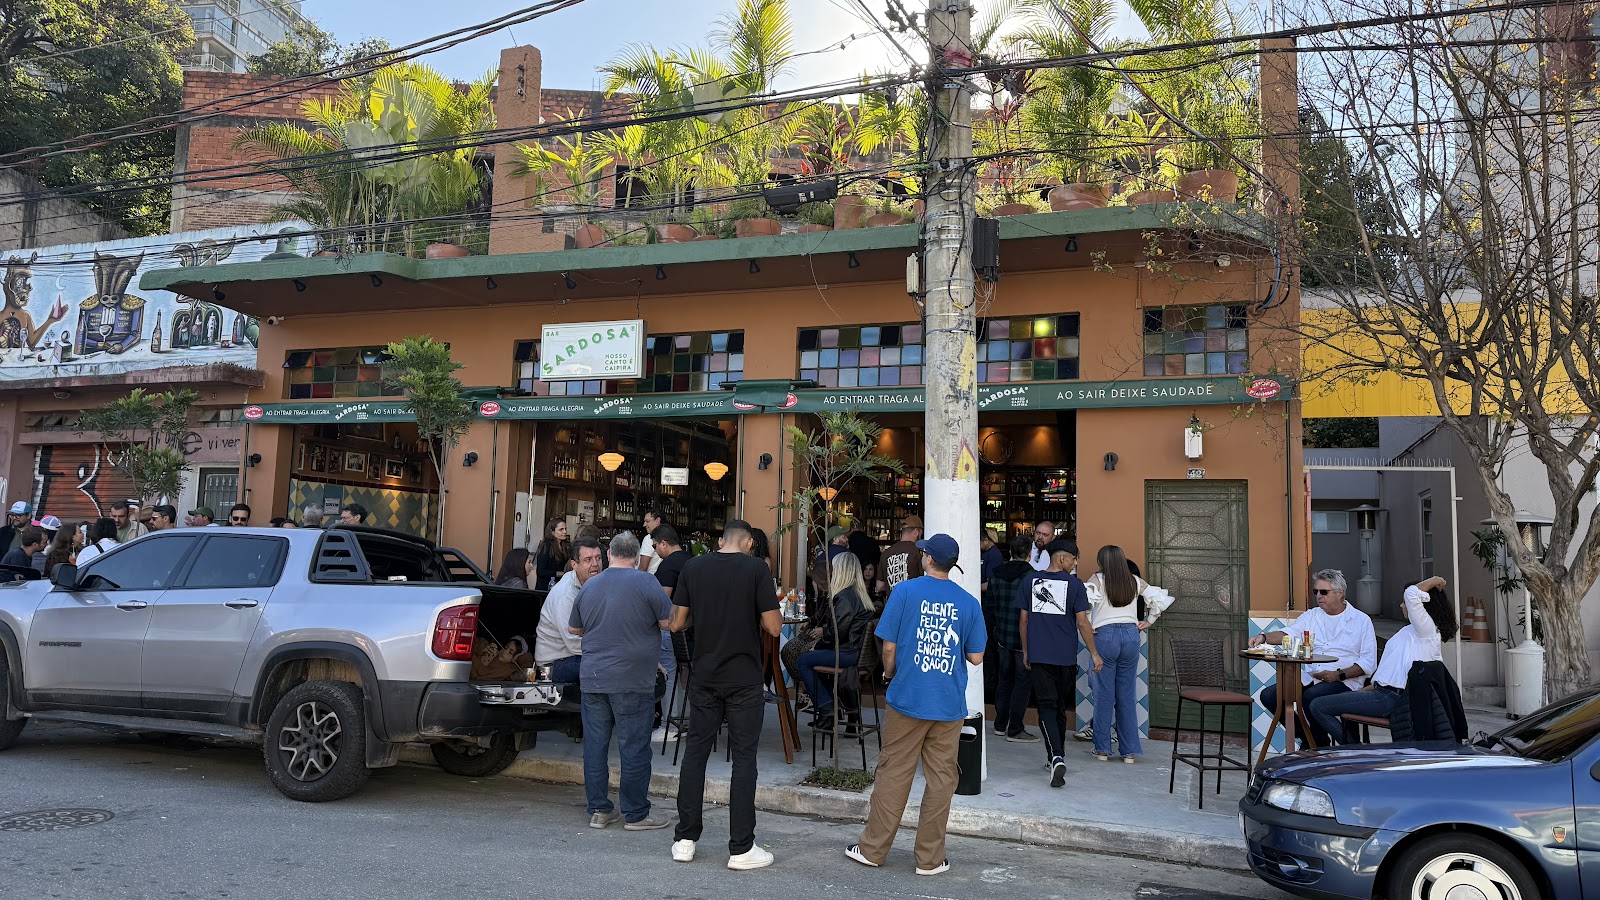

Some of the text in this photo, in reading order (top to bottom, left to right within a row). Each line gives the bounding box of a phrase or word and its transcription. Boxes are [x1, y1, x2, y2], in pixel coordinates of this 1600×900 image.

[823, 395, 837, 404] AO
[839, 395, 875, 404] ENTRAR
[878, 394, 910, 404] TRAGA
[1056, 386, 1213, 400] AO SAIR DEIXE SAUDADE
[920, 600, 959, 620] CLIENTE
[920, 615, 948, 631] FELIZ
[916, 627, 942, 643] NÃO
[917, 641, 952, 659] ENCHE
[914, 654, 956, 676] O SACO!
